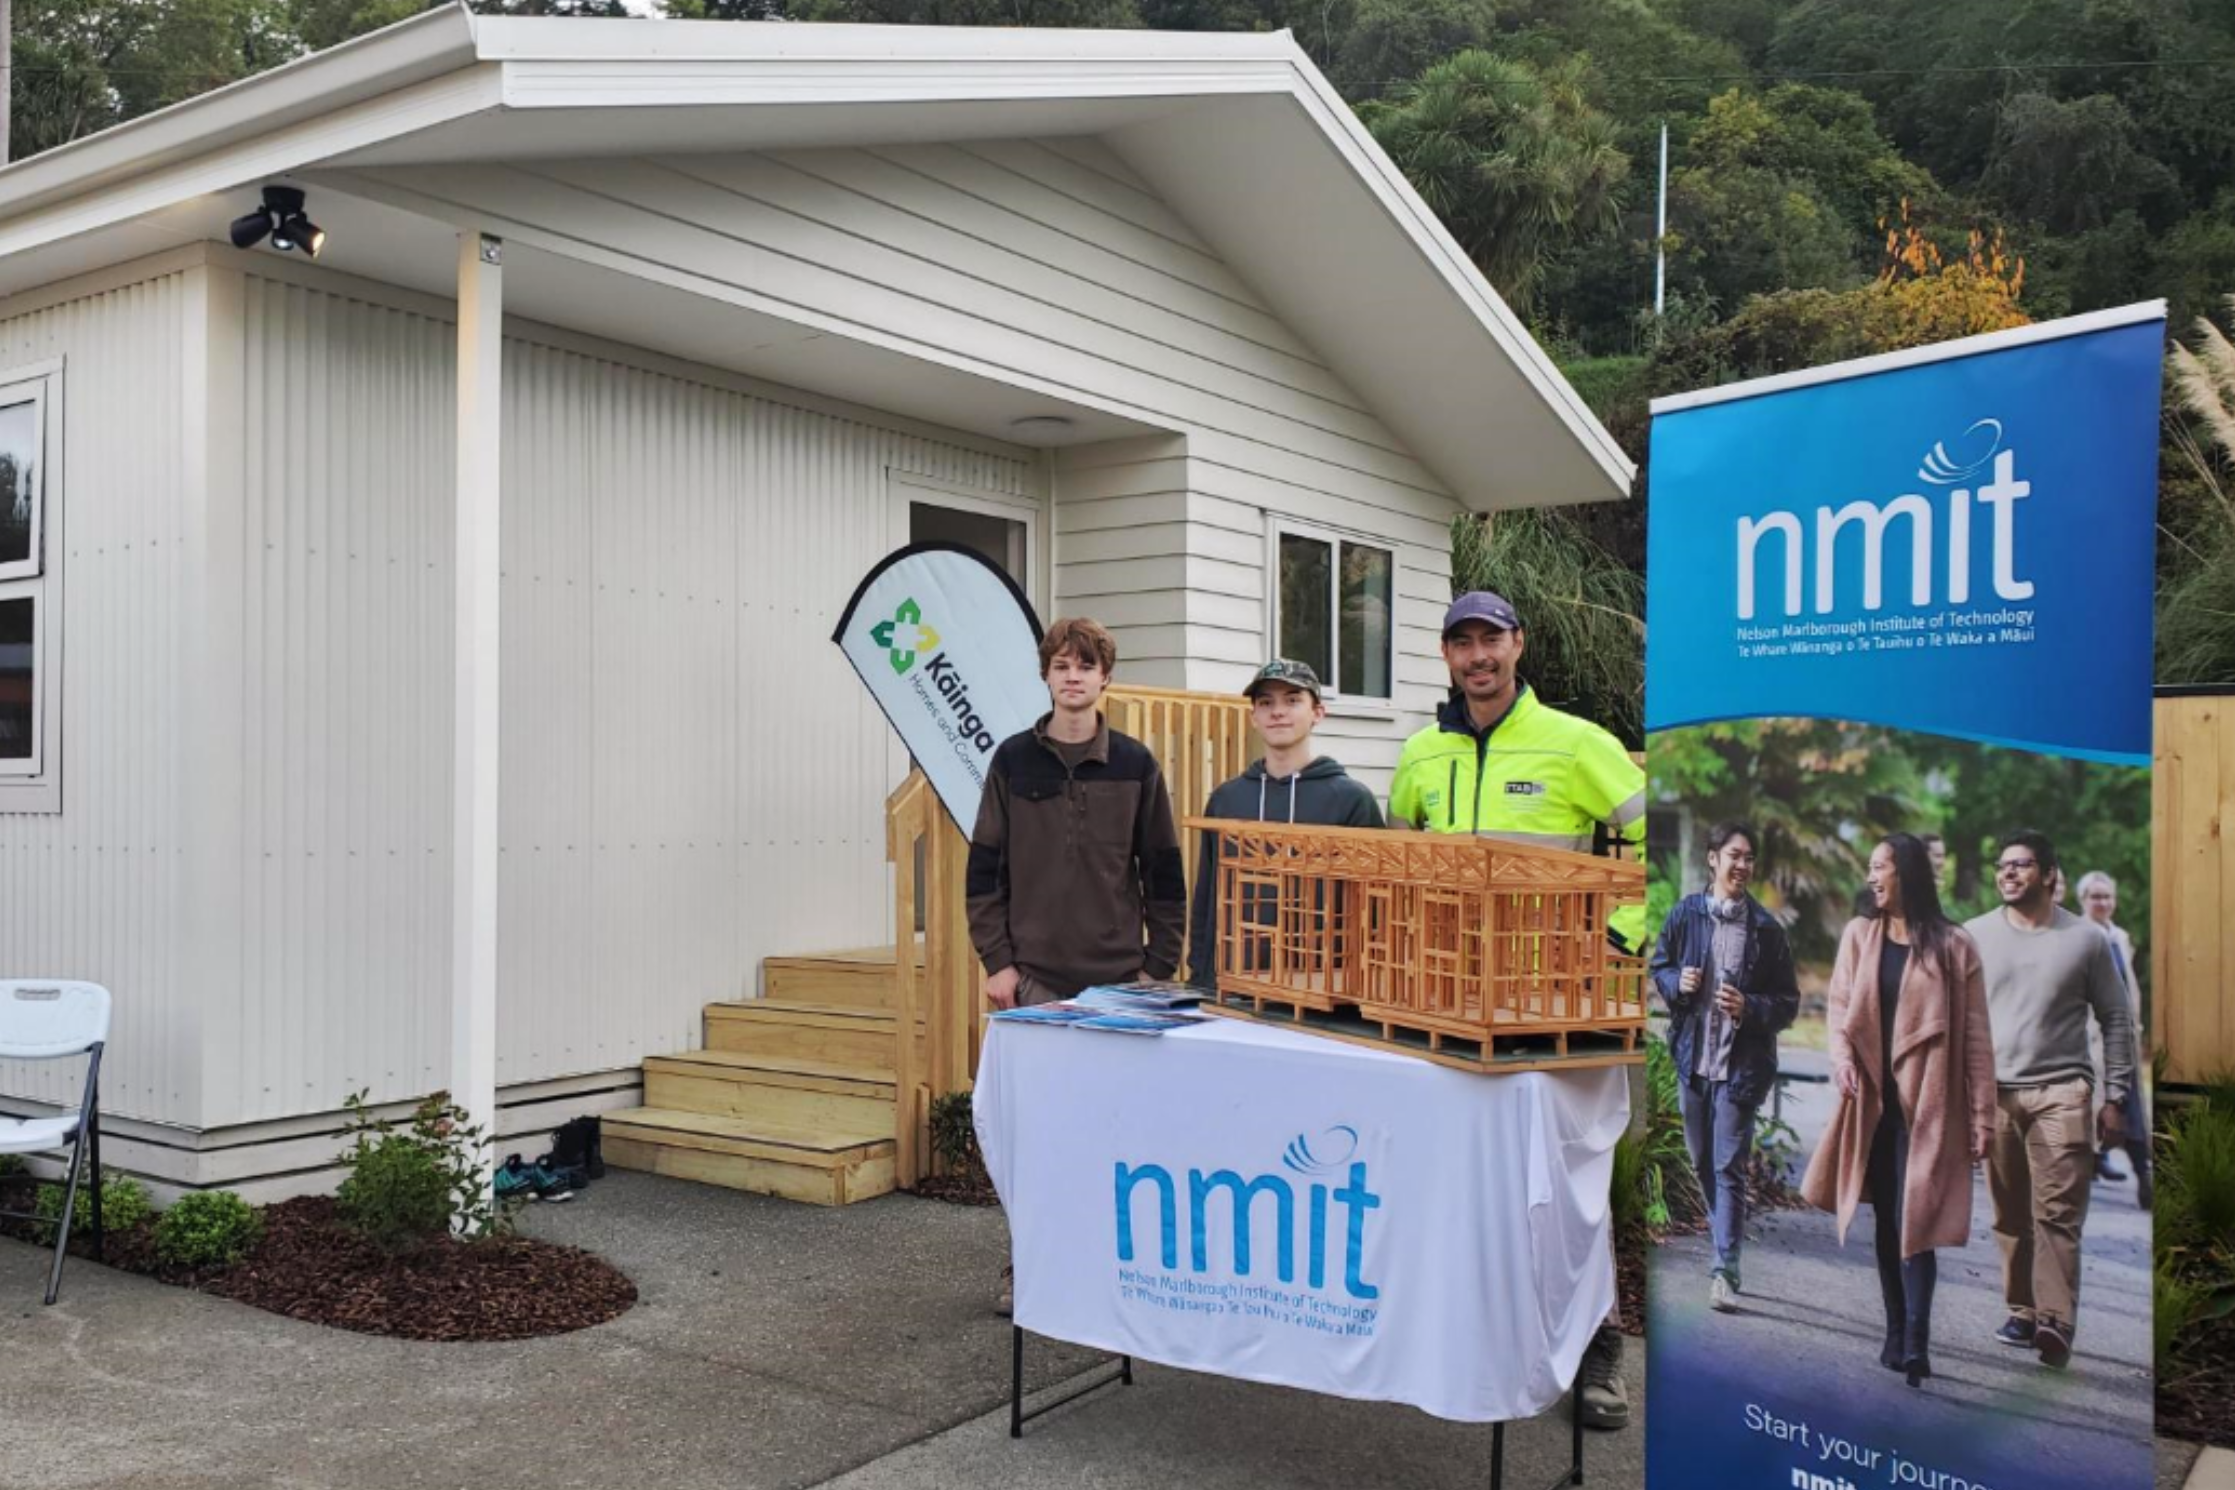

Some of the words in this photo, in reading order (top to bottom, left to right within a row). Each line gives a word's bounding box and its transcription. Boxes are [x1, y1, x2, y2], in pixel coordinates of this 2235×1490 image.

[1737, 448, 2034, 620] nmit
[1737, 626, 1779, 640] Nelson
[1783, 618, 1866, 638] Marlborough
[1870, 615, 1925, 632] Institute
[1929, 611, 1944, 627] of
[1949, 607, 2034, 627] Technology
[1738, 645, 1750, 657] Te
[1752, 643, 1788, 657] Whare
[1846, 640, 1855, 651] o
[1859, 637, 1870, 650] Te
[1916, 636, 1924, 647] o
[1928, 632, 1942, 646] Te
[1947, 630, 1983, 646] Waka
[1988, 632, 1996, 642] a
[909, 673, 940, 718] Homes
[937, 717, 960, 743] and
[924, 651, 995, 754] Kāinga
[1114, 1161, 1380, 1299] nmit
[1119, 1268, 1156, 1287] Nelson
[1160, 1277, 1236, 1299] Marlborough
[1240, 1284, 1289, 1301] Institute
[1292, 1294, 1306, 1308] of
[1306, 1296, 1377, 1323] Technology
[1744, 1404, 1809, 1447] Start
[1818, 1433, 1882, 1470] your
[1890, 1450, 1994, 1490] journ
